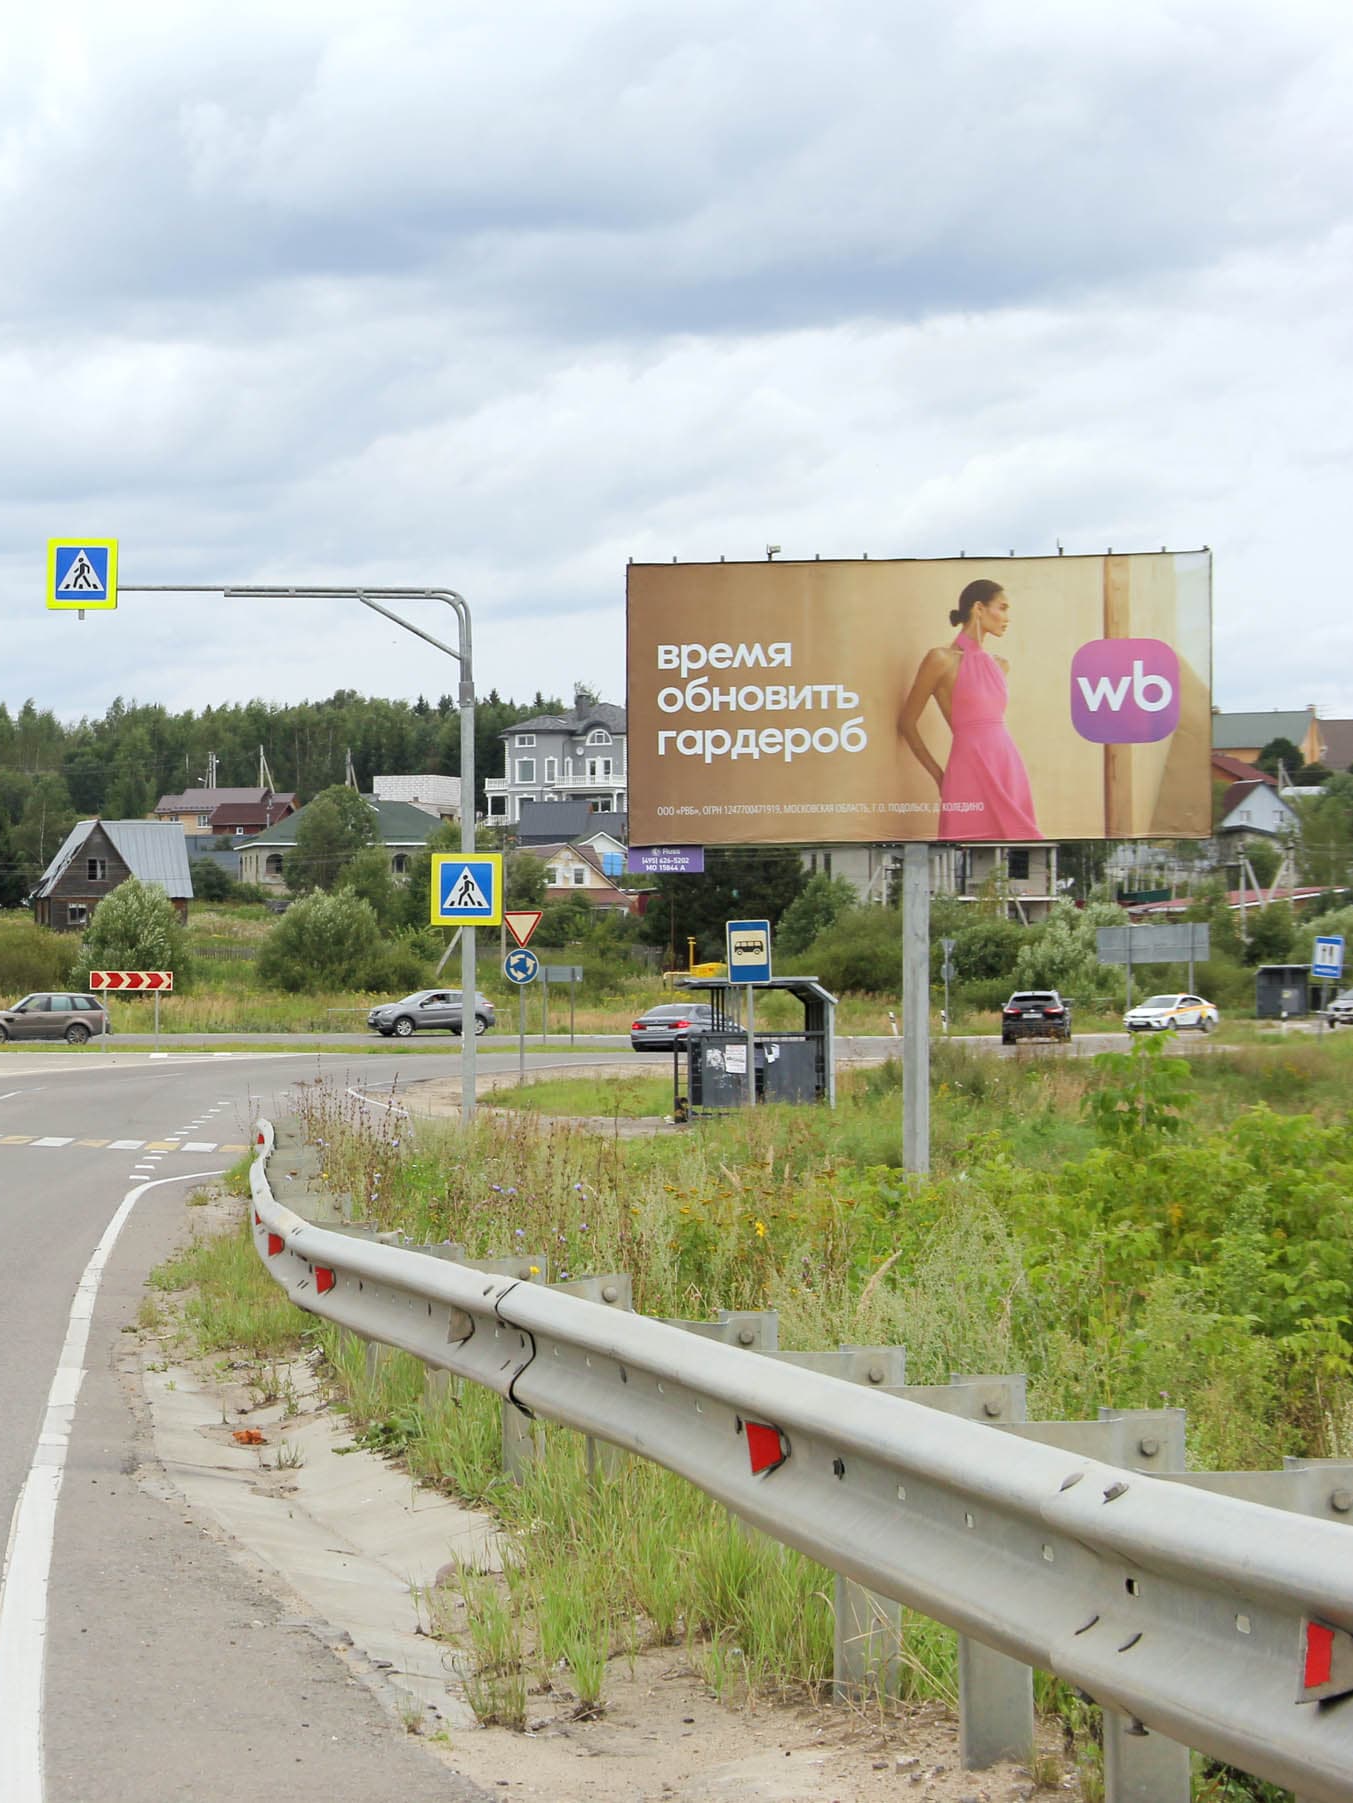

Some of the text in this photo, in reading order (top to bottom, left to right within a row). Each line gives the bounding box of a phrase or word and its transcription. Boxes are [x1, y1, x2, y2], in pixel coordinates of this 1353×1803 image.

[657, 642, 792, 678] время
[657, 676, 860, 713] обновить
[1076, 660, 1173, 712] wb
[657, 716, 868, 764] гардероб
[657, 806, 675, 816] ООО
[702, 805, 722, 815] ОГРН
